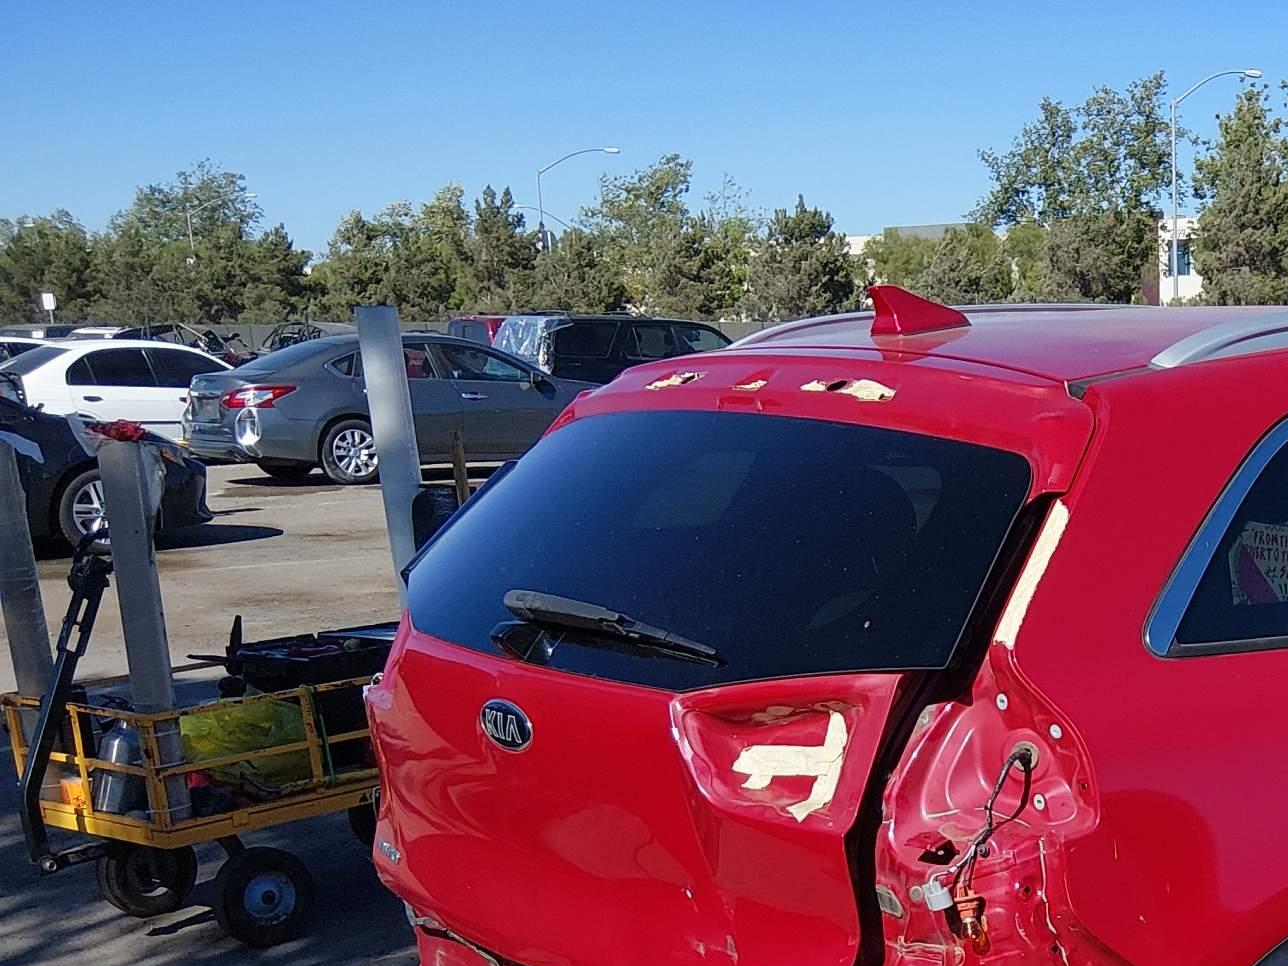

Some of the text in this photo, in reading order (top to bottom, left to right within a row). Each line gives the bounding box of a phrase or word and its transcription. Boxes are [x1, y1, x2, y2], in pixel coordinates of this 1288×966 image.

[1253, 530, 1281, 546] FROM
[1266, 547, 1280, 561] TO
[485, 708, 522, 743] KIA
